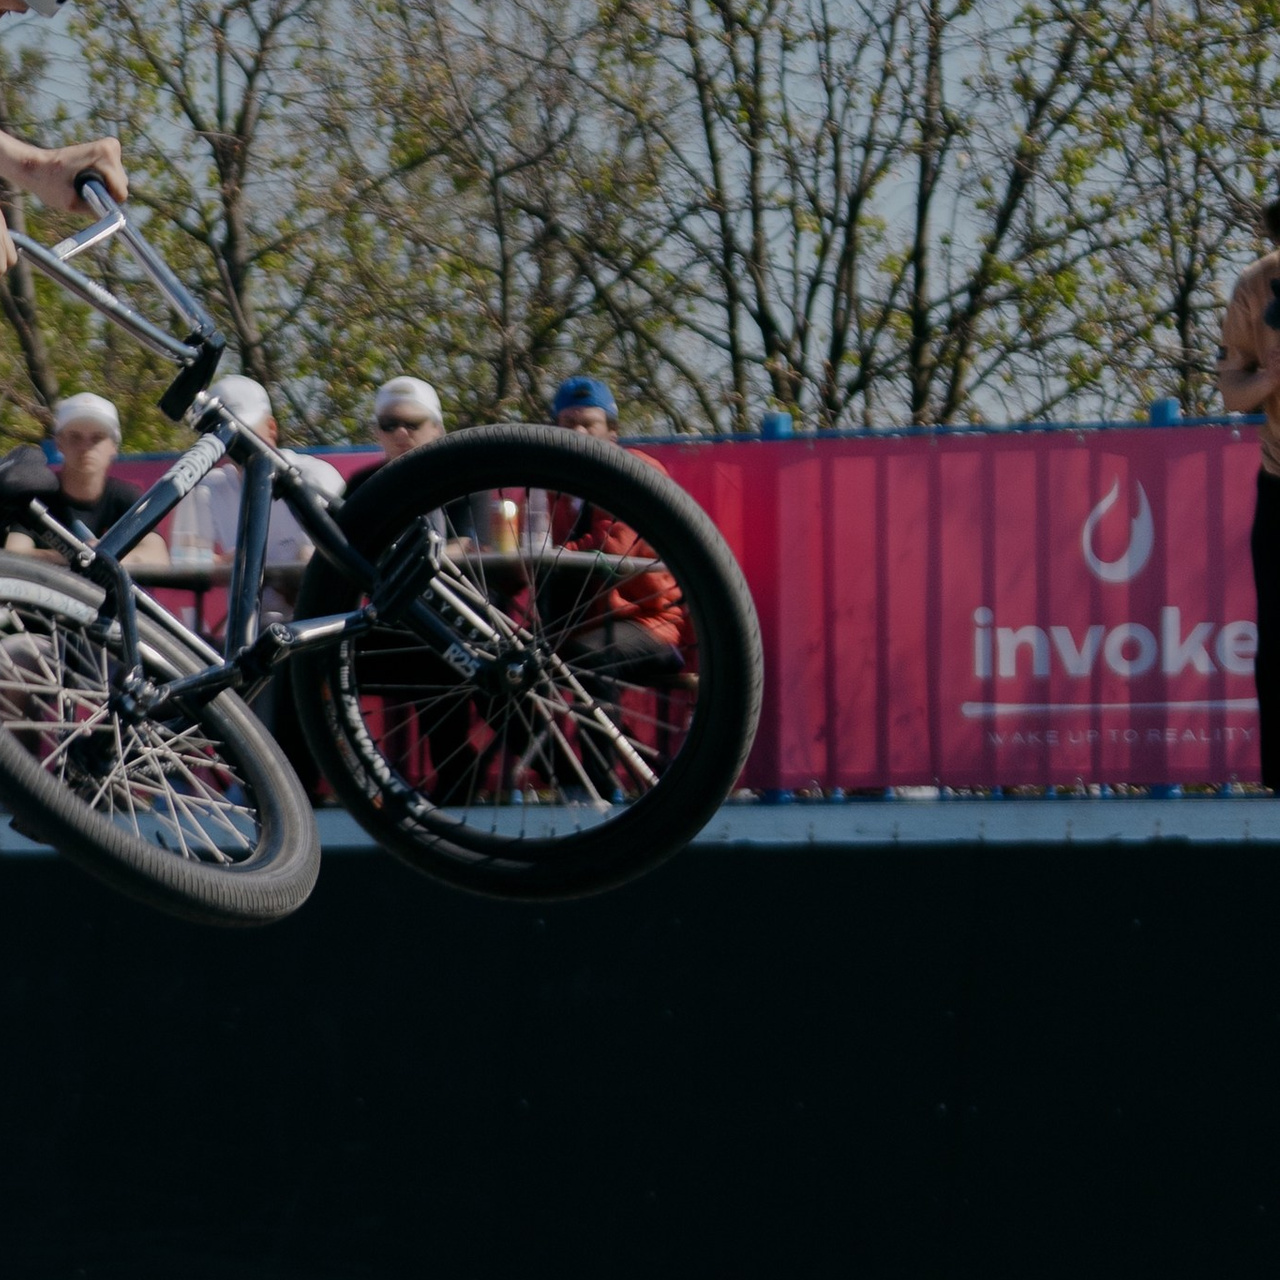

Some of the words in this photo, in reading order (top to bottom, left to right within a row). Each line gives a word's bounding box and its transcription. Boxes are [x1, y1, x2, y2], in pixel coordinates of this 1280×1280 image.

[973, 606, 1258, 677] invoke
[987, 729, 1059, 746] WAKE
[1069, 729, 1099, 745] UP
[1110, 728, 1138, 743] TO
[1147, 726, 1254, 743] REALITY
